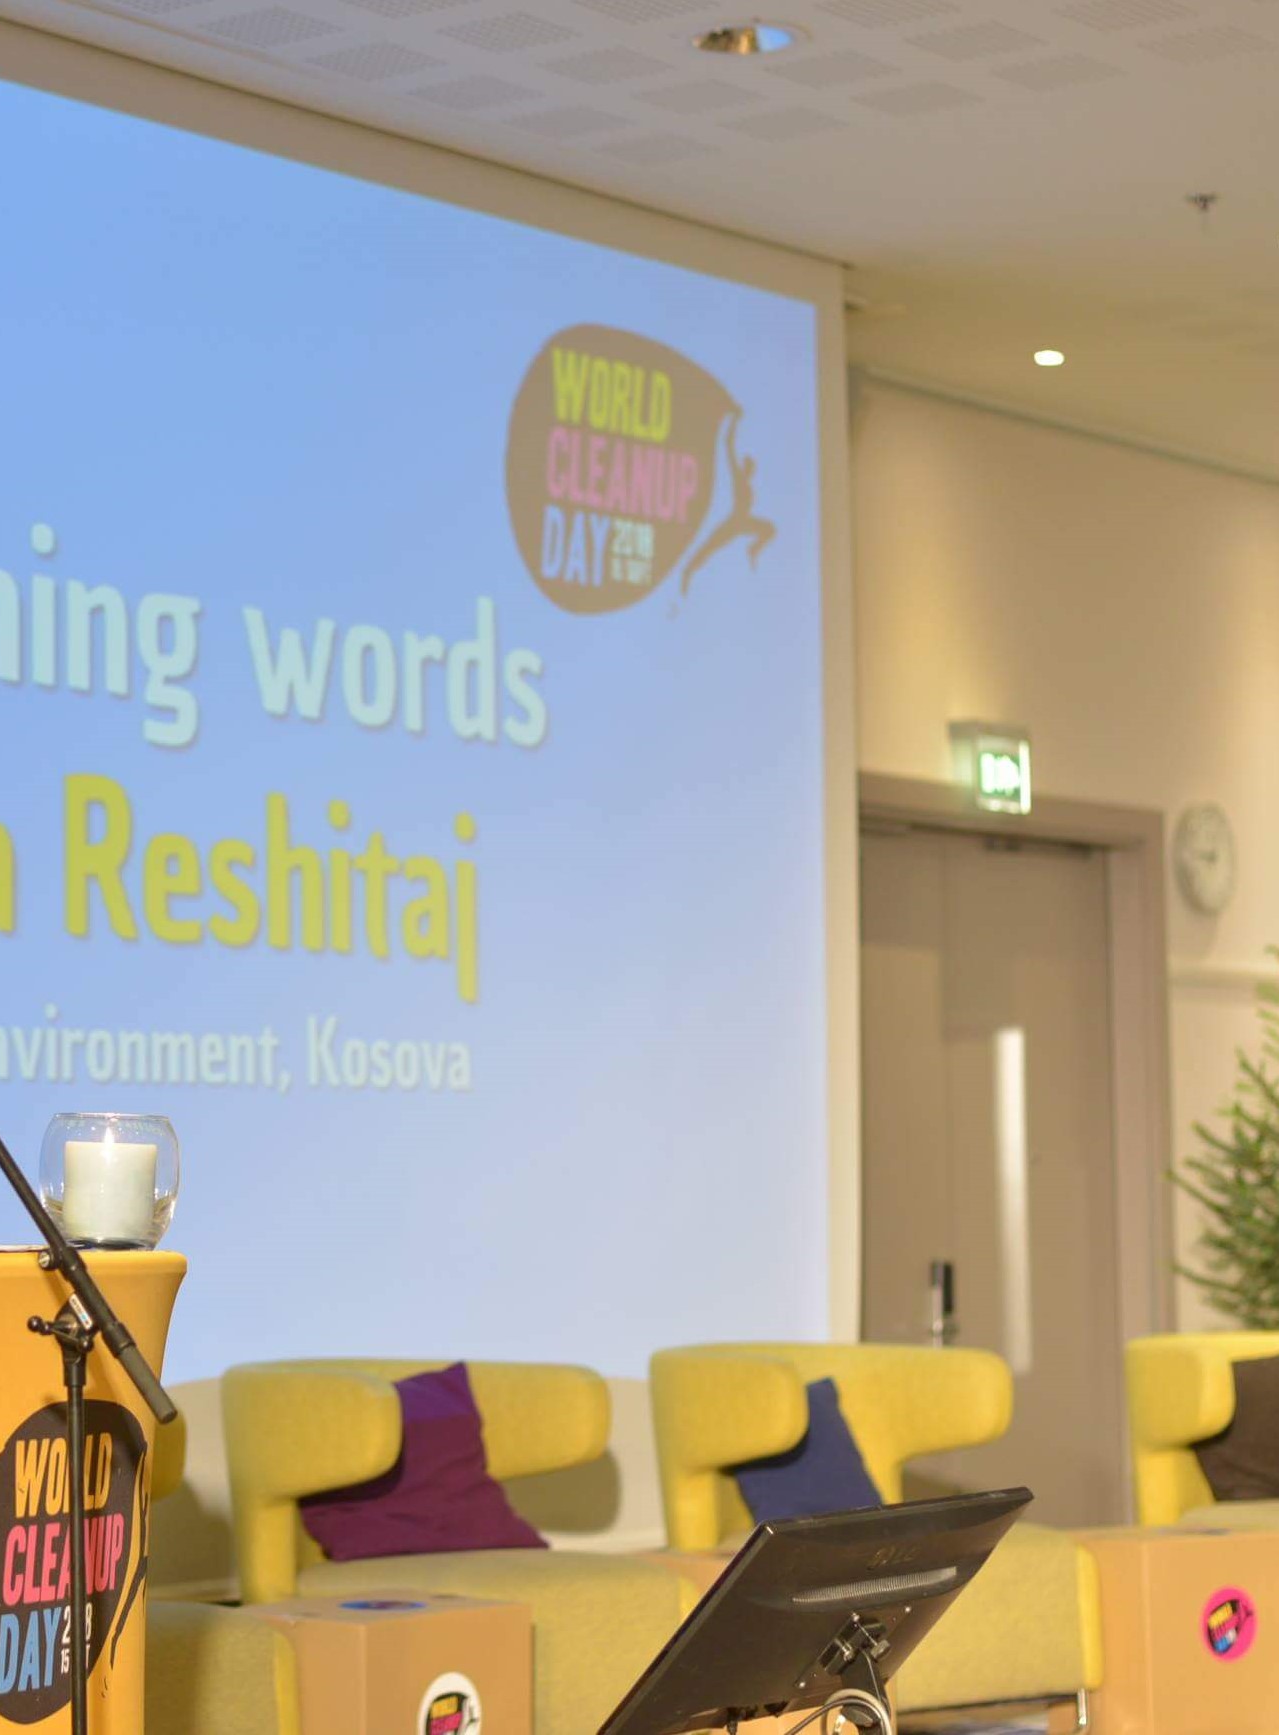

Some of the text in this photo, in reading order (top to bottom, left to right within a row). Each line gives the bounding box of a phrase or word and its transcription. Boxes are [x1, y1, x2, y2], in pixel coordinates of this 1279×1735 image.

[552, 347, 671, 444] WORLD
[546, 424, 699, 525] CLEANUP
[540, 503, 610, 588] DAY
[243, 595, 547, 748] words
[64, 772, 477, 1004] Reshitaj
[307, 1013, 470, 1090] Kosova
[15, 1432, 113, 1519] WOLD
[62, 1603, 93, 1645] 28
